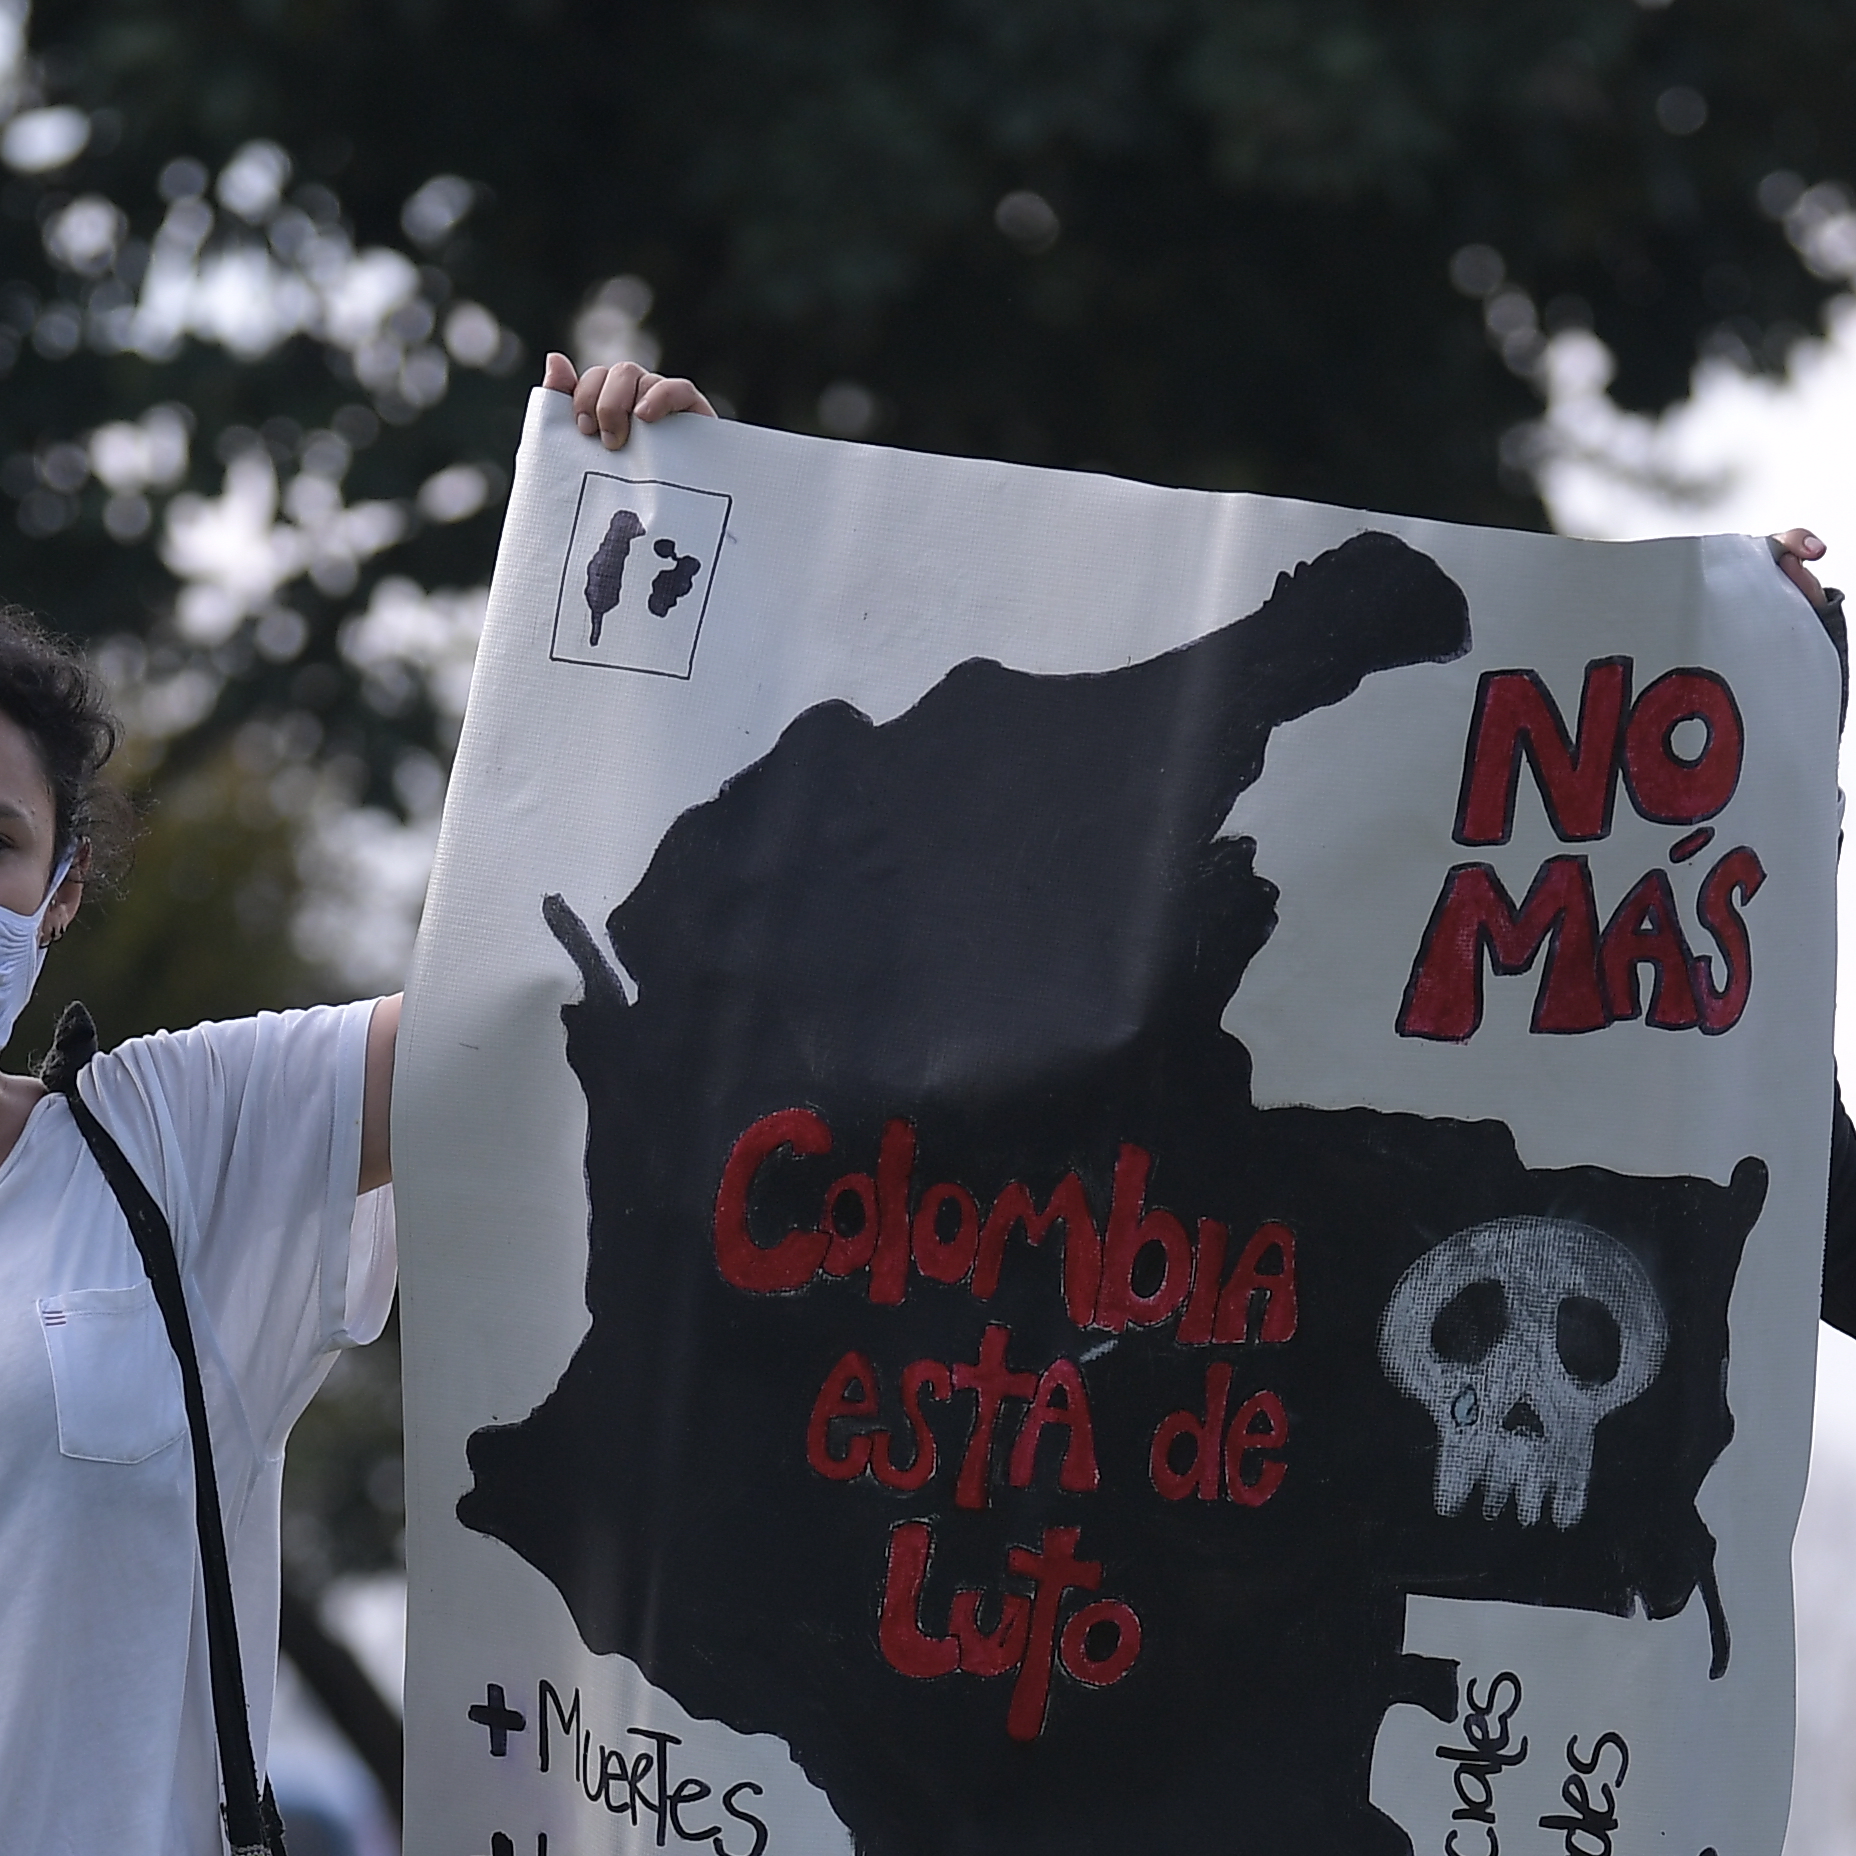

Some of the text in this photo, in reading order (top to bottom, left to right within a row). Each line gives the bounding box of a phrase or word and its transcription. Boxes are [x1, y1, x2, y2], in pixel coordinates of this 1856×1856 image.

[1452, 655, 1745, 847] NO
[1395, 826, 1768, 1045] MÁS
[1148, 1361, 1289, 1508] de
[877, 1517, 1143, 1743] Luto
